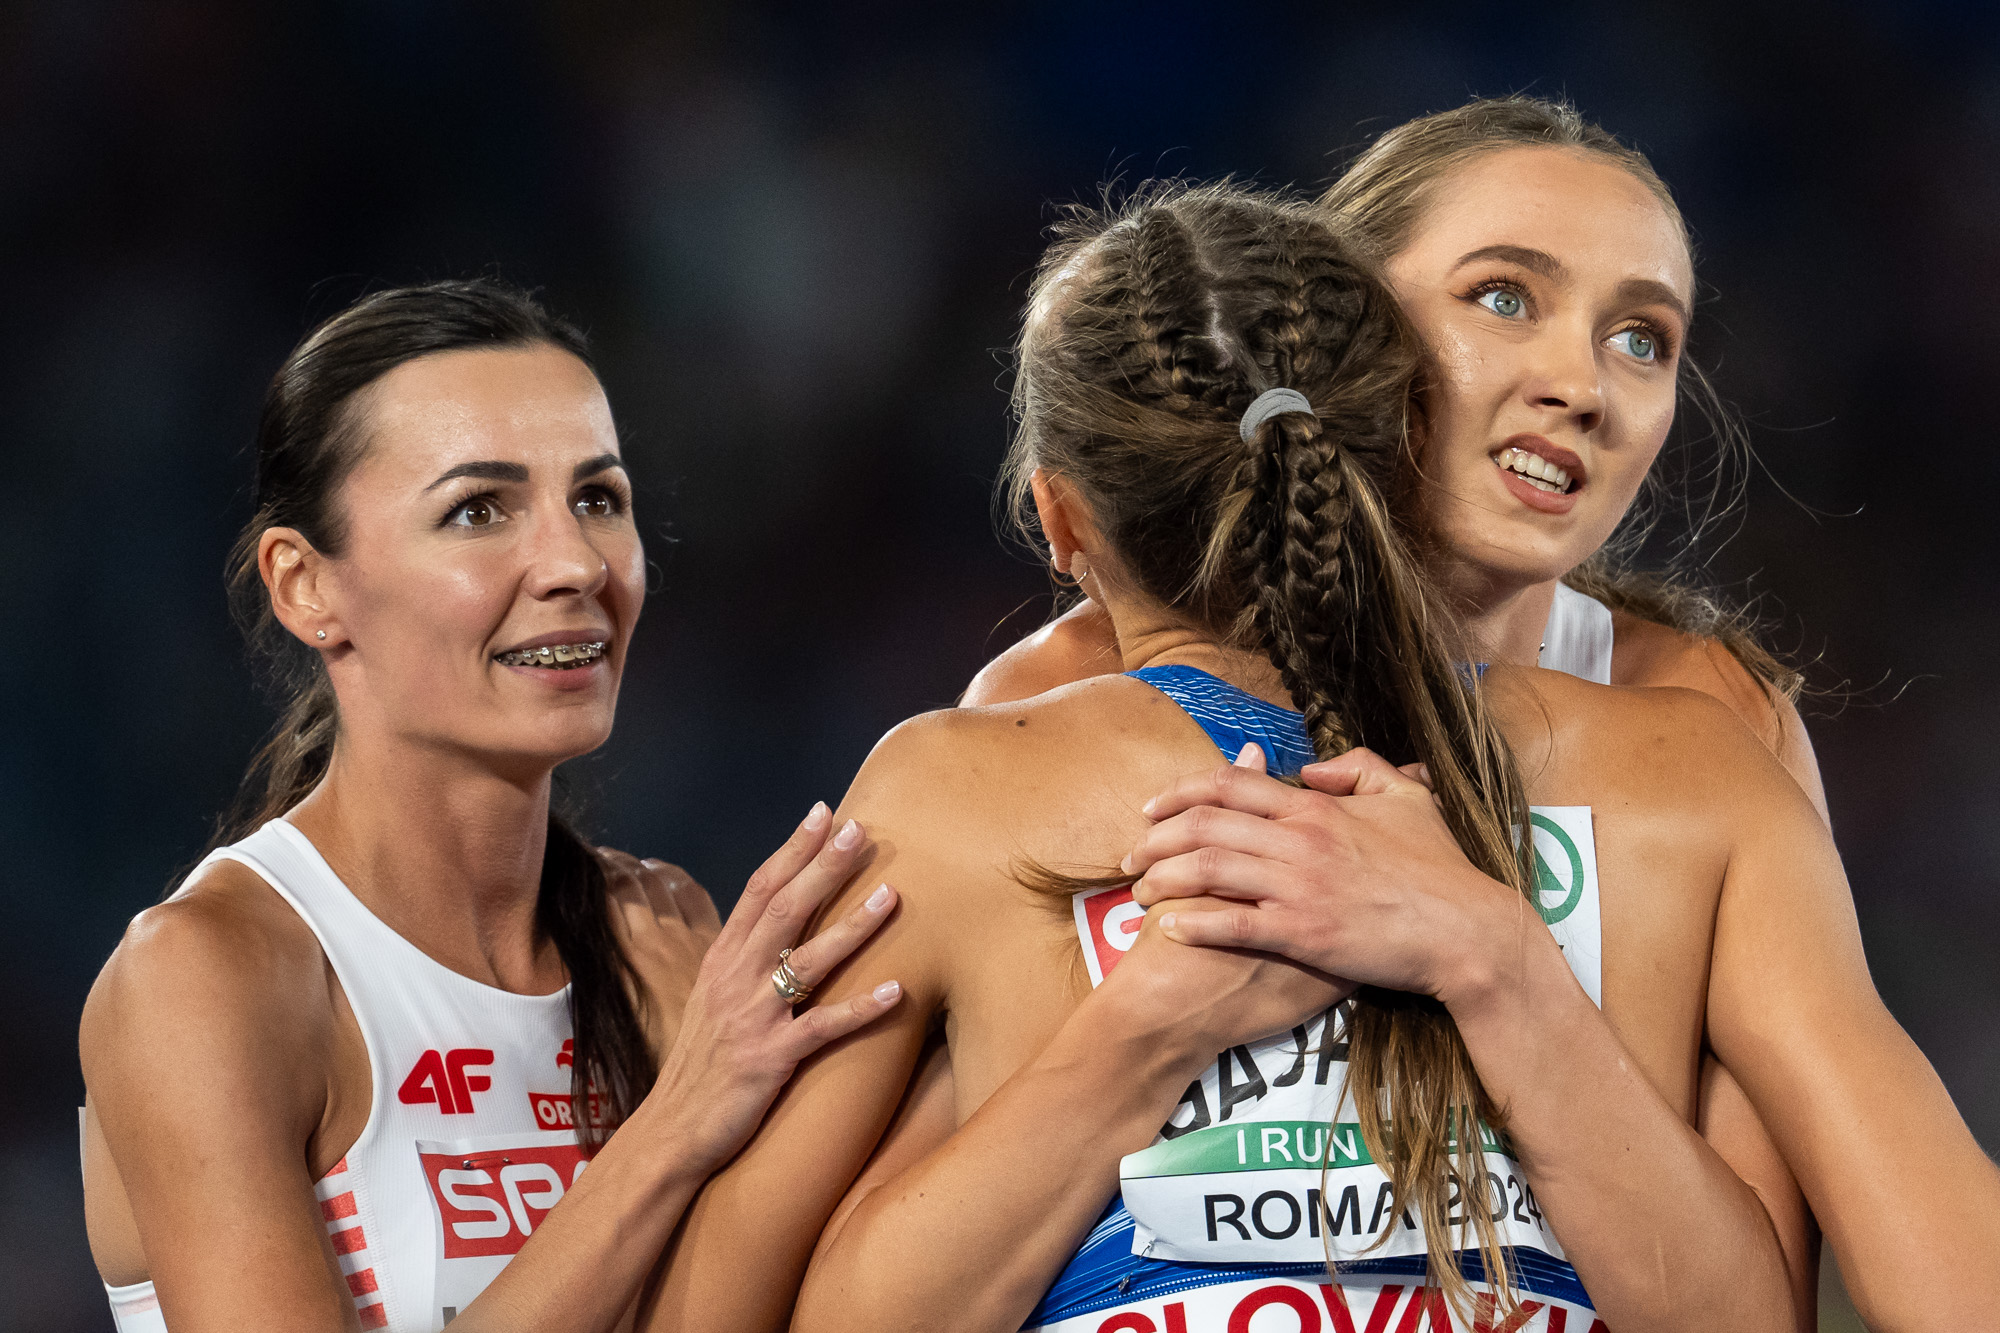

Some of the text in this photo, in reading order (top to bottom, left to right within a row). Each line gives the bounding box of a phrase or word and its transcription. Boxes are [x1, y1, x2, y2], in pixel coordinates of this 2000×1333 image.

[397, 1048, 494, 1115] 4F
[1236, 1128, 1247, 1165] I
[1260, 1126, 1360, 1164] RUN
[437, 1160, 590, 1240] SP
[1203, 1181, 1417, 1242] ROMA
